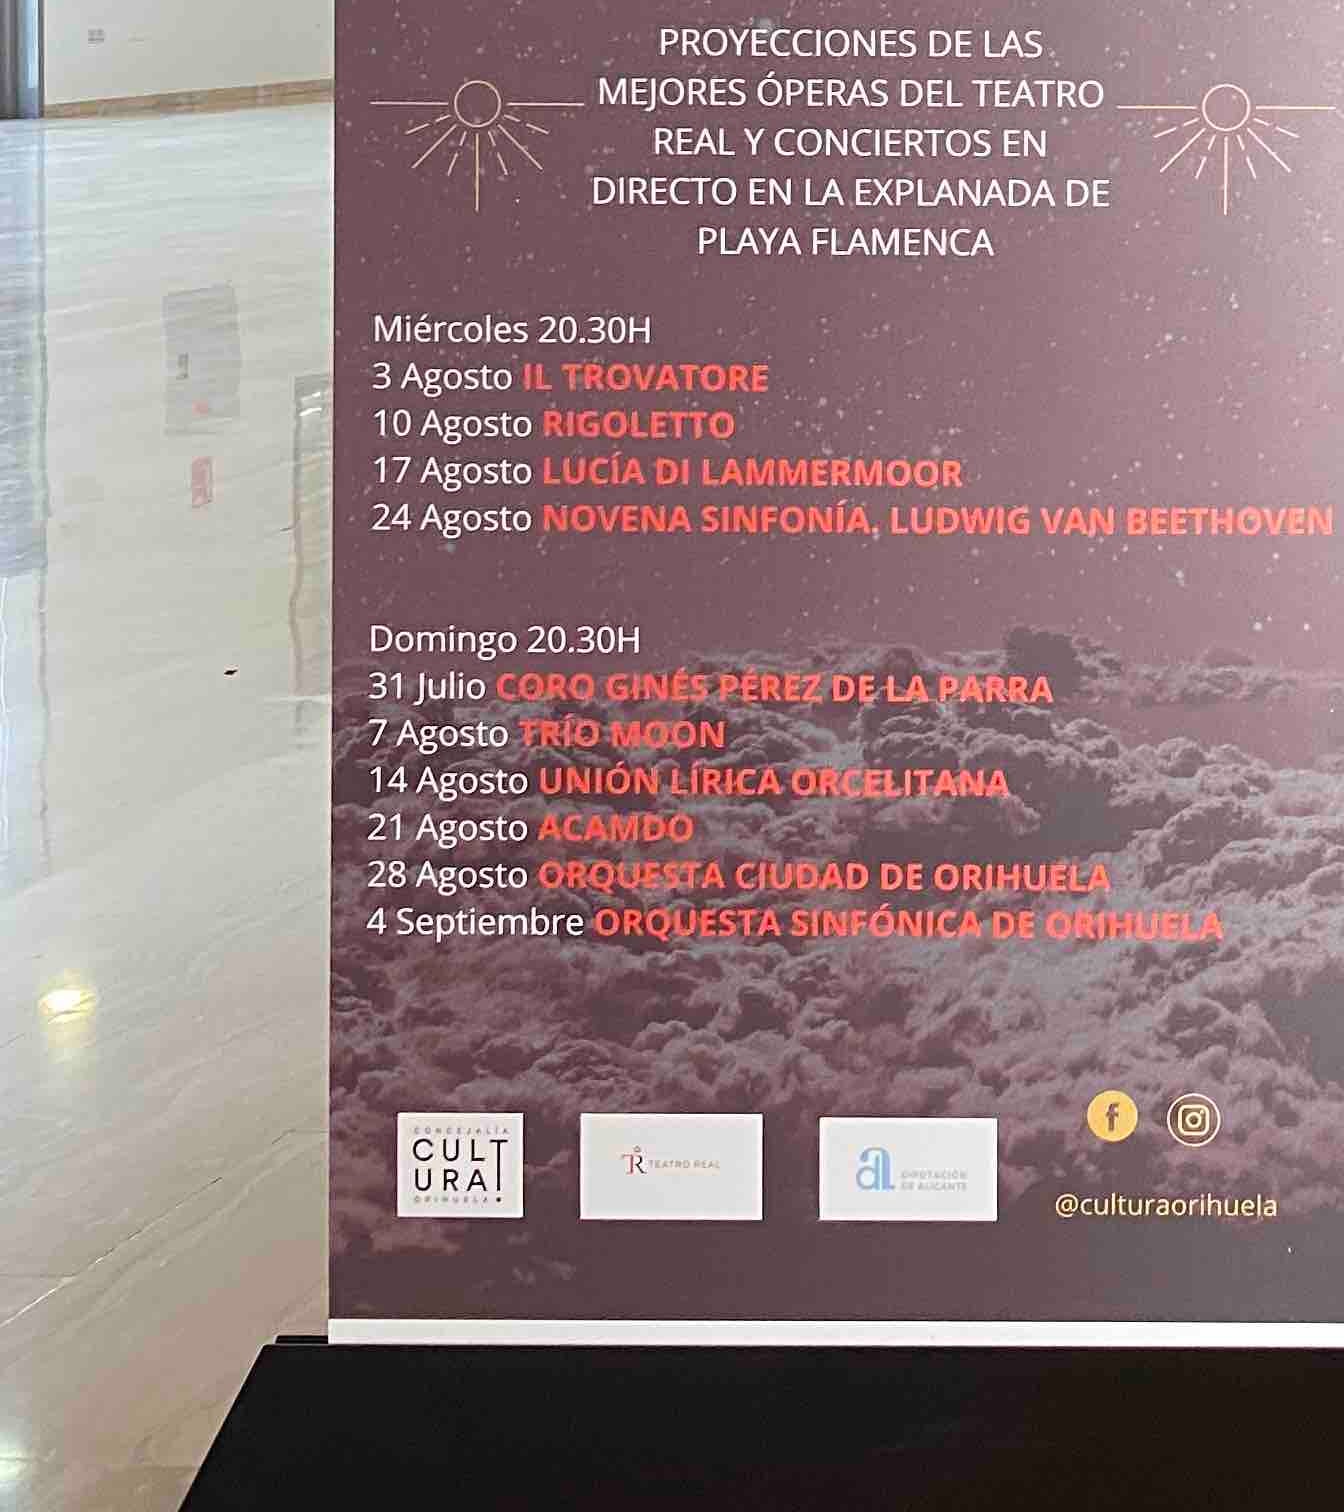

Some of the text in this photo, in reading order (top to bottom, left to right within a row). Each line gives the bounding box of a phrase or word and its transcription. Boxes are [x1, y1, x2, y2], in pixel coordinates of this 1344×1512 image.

[659, 27, 1044, 59] PROYECCIONES DE LAS
[598, 70, 1105, 113] MEJORES ÓPERAS DEL TEATRO
[653, 126, 1048, 159] REAL Y CONCIERTOS EN
[592, 175, 1111, 208] DIRECTO EN LA EXPLANADA DE
[697, 226, 996, 258] PLAYA FLAMENCA
[373, 313, 652, 345] Miércoles 20.30H
[371, 361, 768, 399] 3 Agosto IL TROVATORE
[373, 408, 737, 446] 10 Agosto RIGOLETTO
[373, 449, 962, 493] 17 Agosto LUCÍA DI LAMMERMOOR
[649, 1160, 720, 1169] TEATRO REAL
[1055, 1192, 1278, 1219] @culturaorihuela
